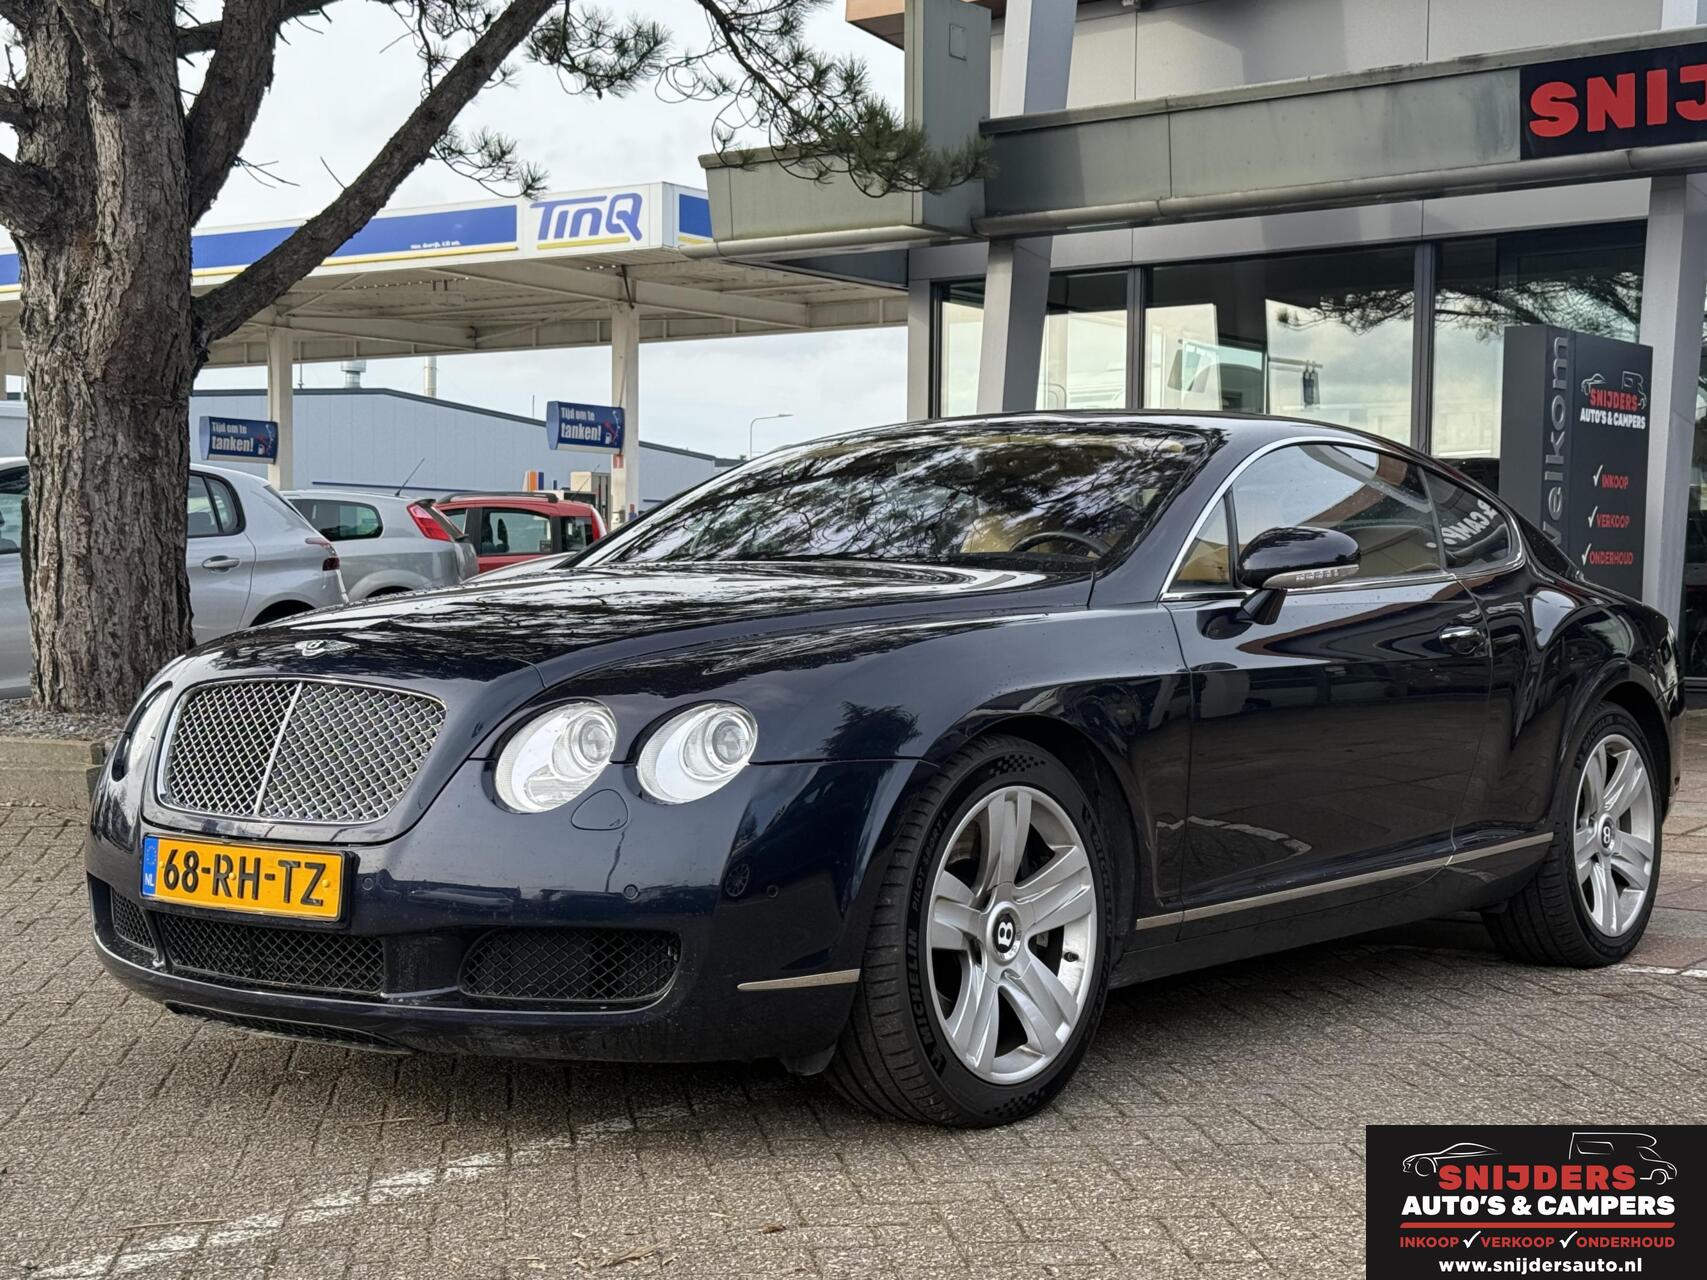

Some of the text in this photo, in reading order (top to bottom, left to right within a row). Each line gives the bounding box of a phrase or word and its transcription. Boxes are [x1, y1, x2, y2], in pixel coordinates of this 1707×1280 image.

[1590, 388, 1638, 412] SNIJDERS
[561, 407, 575, 419] Tijd
[587, 411, 596, 421] te
[1580, 408, 1646, 430] AUTO'S & CAMPERS
[211, 422, 226, 433] Tijd
[226, 425, 239, 433] om
[561, 422, 602, 441] tanken!
[211, 436, 254, 452] tanken!
[1602, 474, 1629, 489] INKOOP
[1597, 514, 1630, 528] VERKOOP
[1589, 551, 1634, 565] ONDERHOUD
[143, 873, 155, 887] NL
[163, 849, 327, 907] 68-RH-TZ
